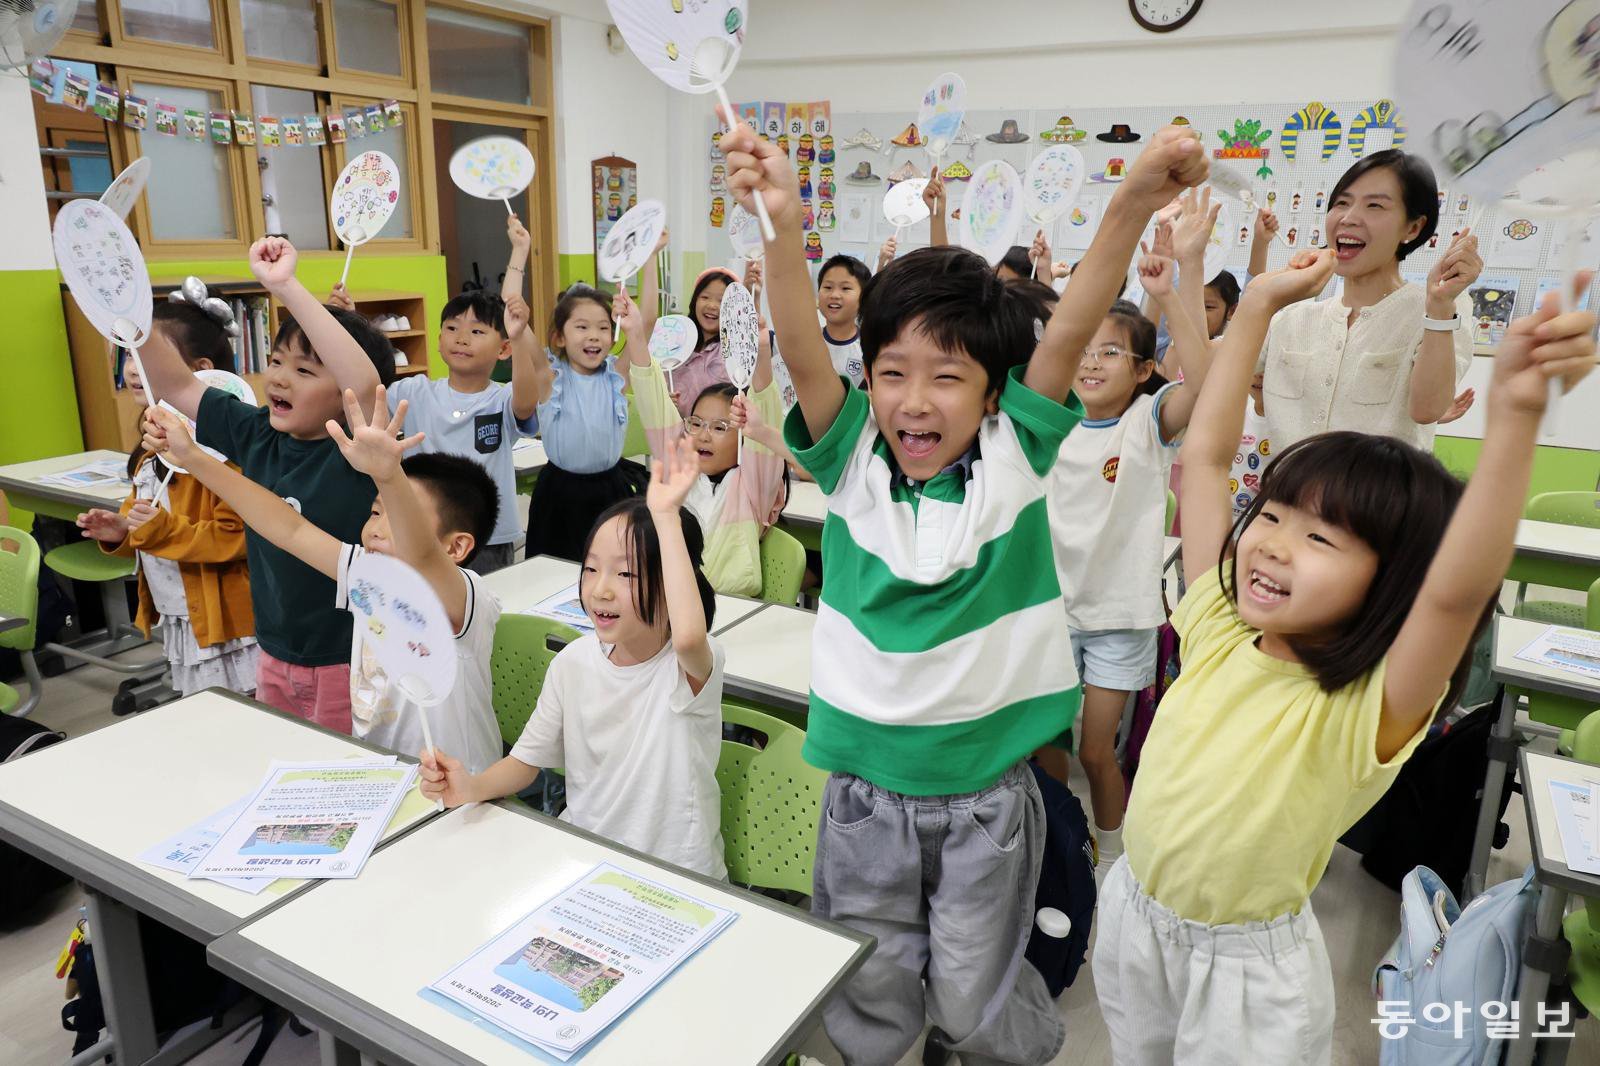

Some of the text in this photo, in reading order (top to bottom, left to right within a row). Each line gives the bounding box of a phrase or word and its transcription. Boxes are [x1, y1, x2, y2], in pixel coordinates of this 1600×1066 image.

[768, 120, 826, 134] 축하해
[489, 983, 560, 1021] 나의 학교생활
